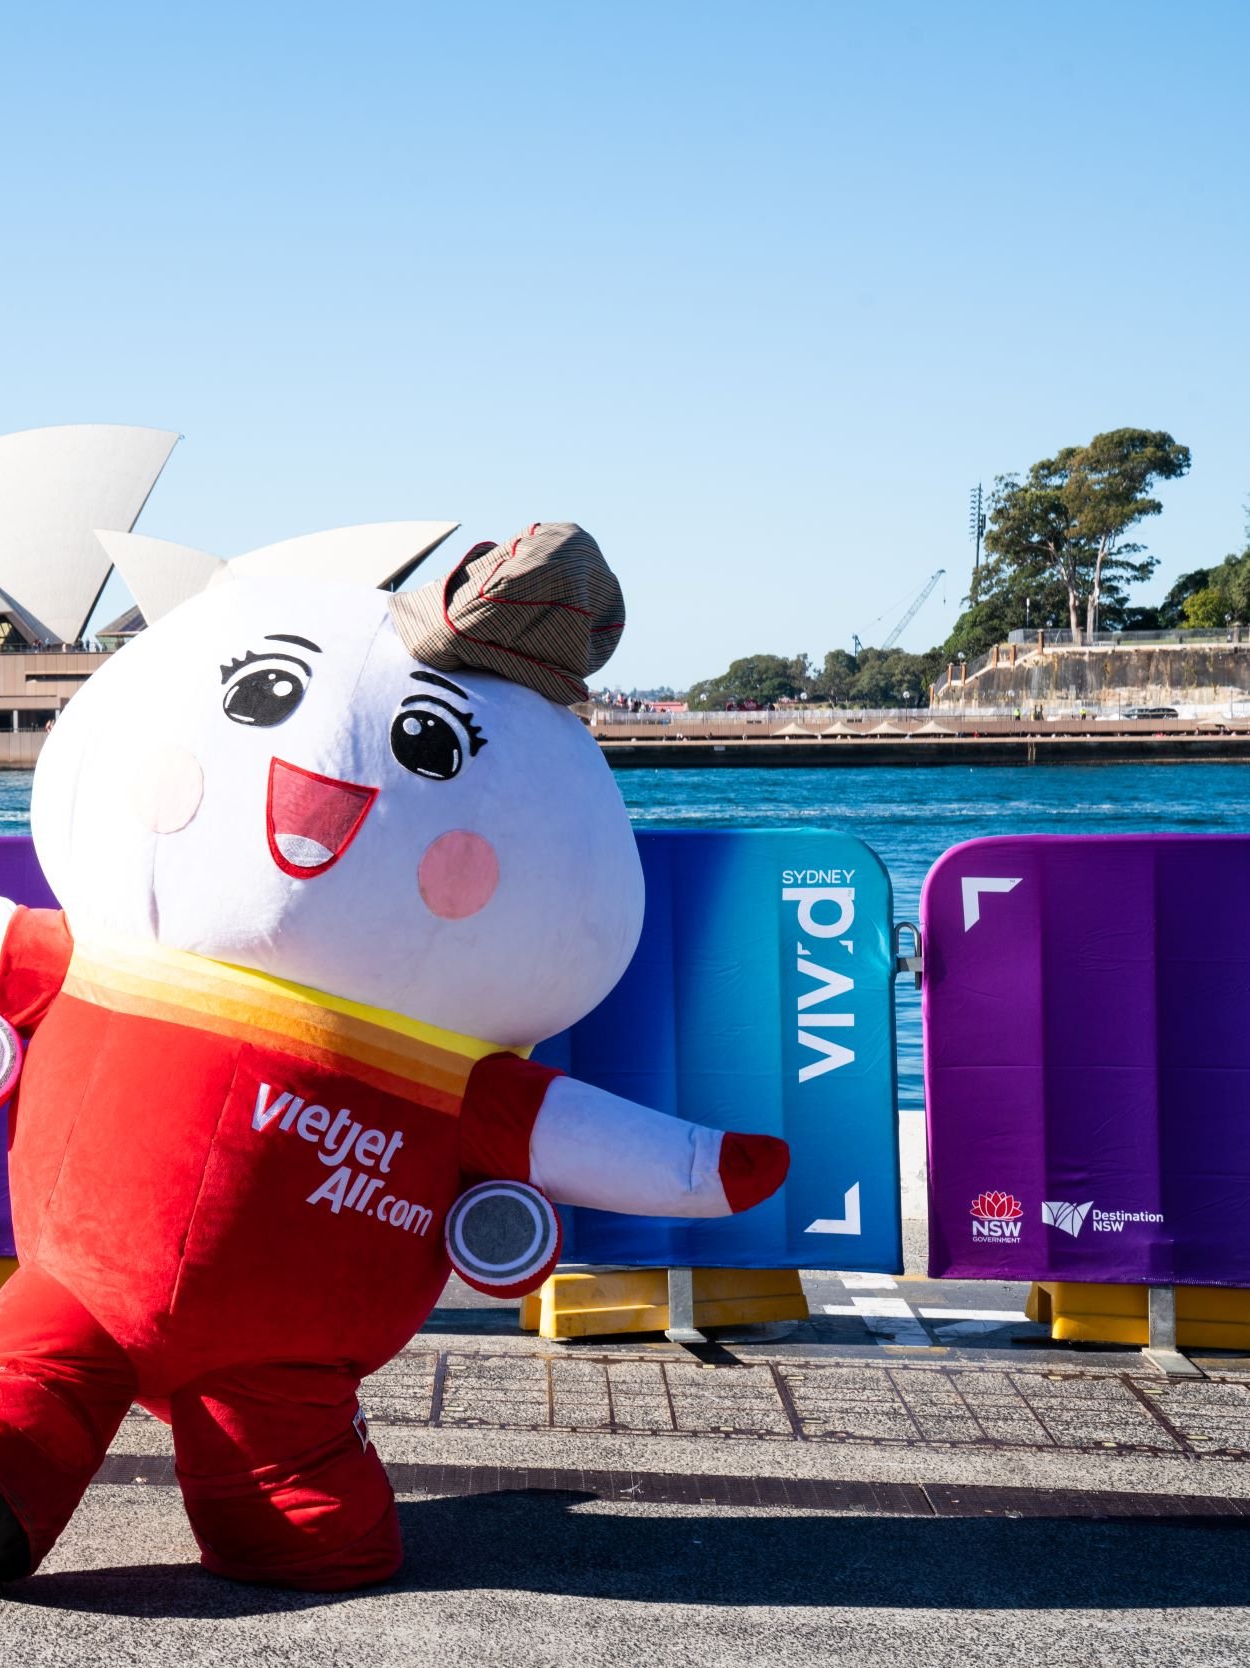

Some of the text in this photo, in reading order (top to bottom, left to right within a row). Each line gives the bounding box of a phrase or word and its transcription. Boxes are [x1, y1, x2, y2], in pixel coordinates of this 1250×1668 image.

[782, 869, 856, 884] SYDNEY
[1092, 1209, 1165, 1223] Destination
[972, 1220, 1022, 1237] NSW
[1093, 1221, 1125, 1232] NSW
